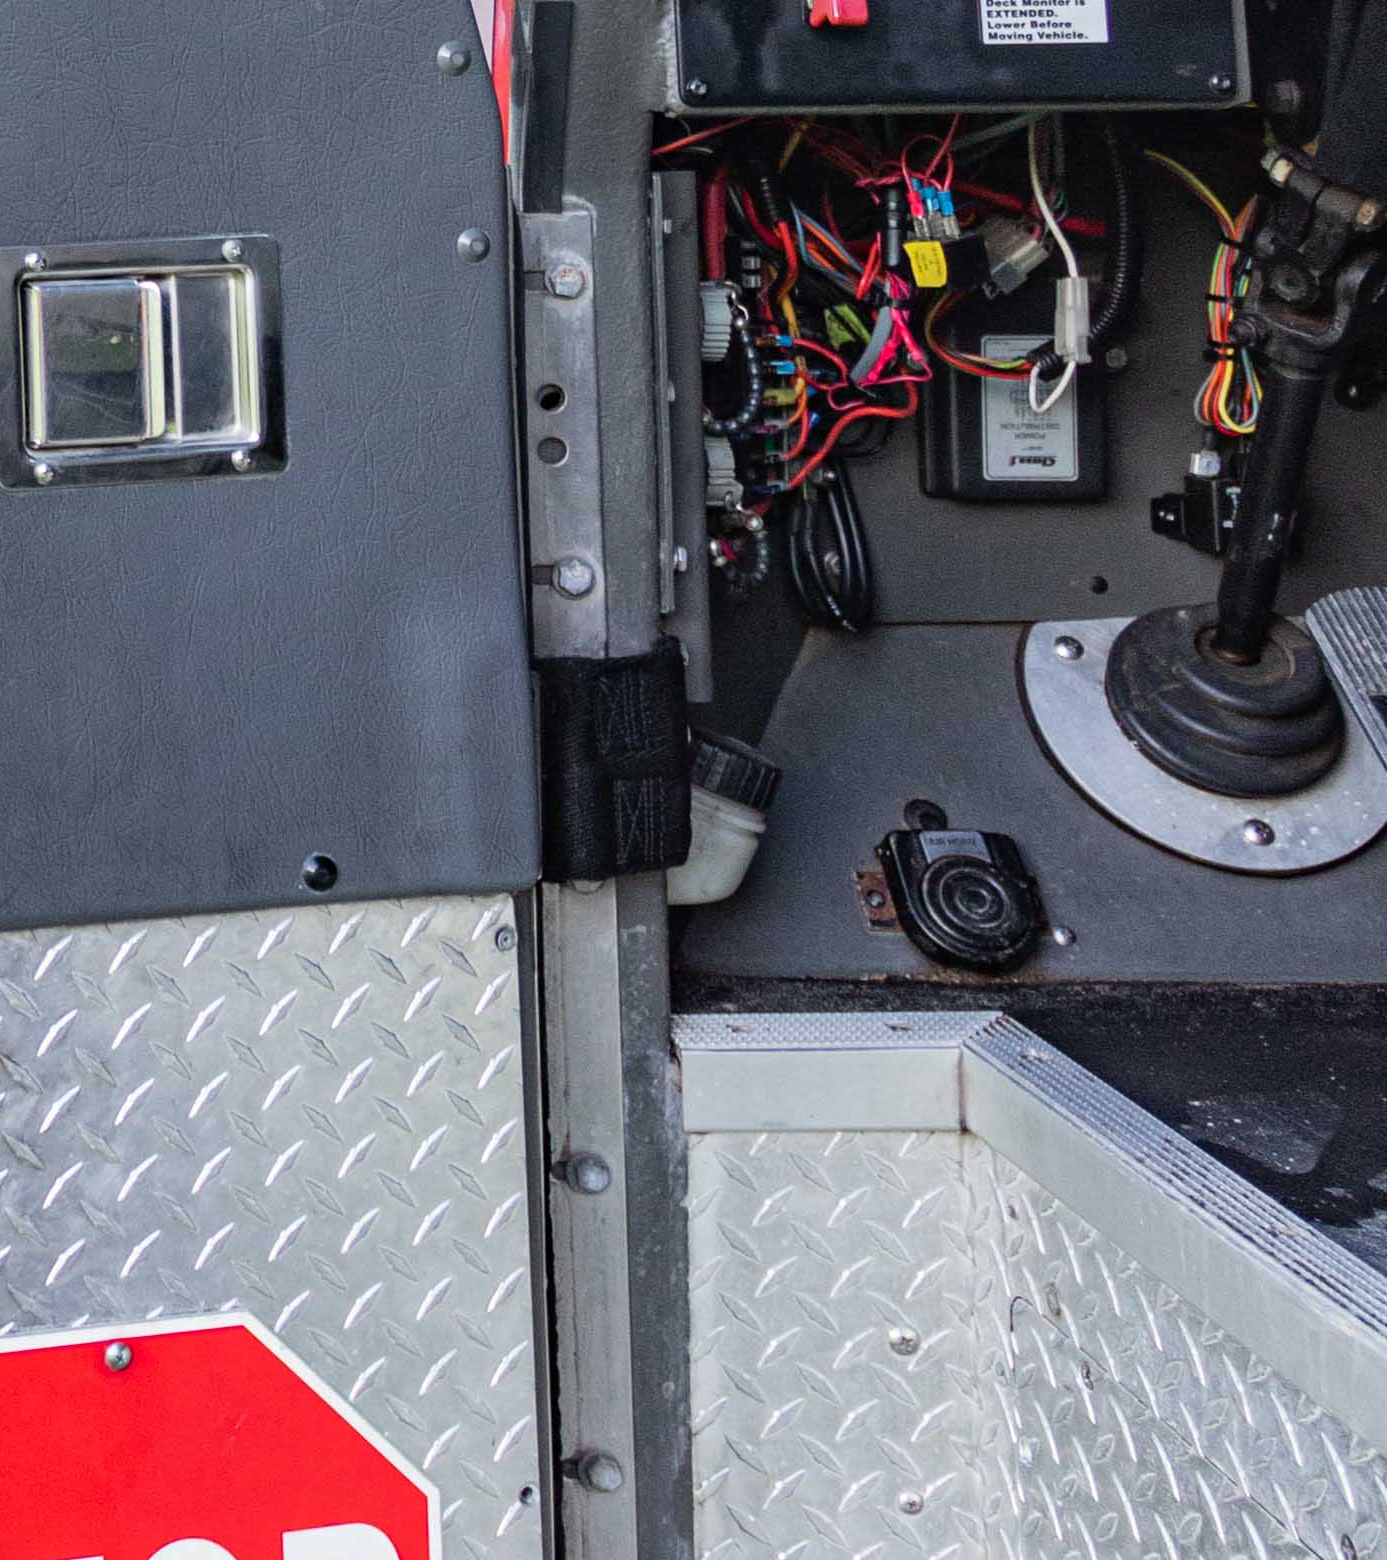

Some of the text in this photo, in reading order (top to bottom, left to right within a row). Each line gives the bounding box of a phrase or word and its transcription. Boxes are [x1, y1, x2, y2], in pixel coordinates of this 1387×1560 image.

[986, 0, 1017, 7] Deck
[987, 10, 1058, 18] EXTENDED.
[988, 21, 1025, 29] Lower
[989, 31, 1088, 40] Moving Vehicle.
